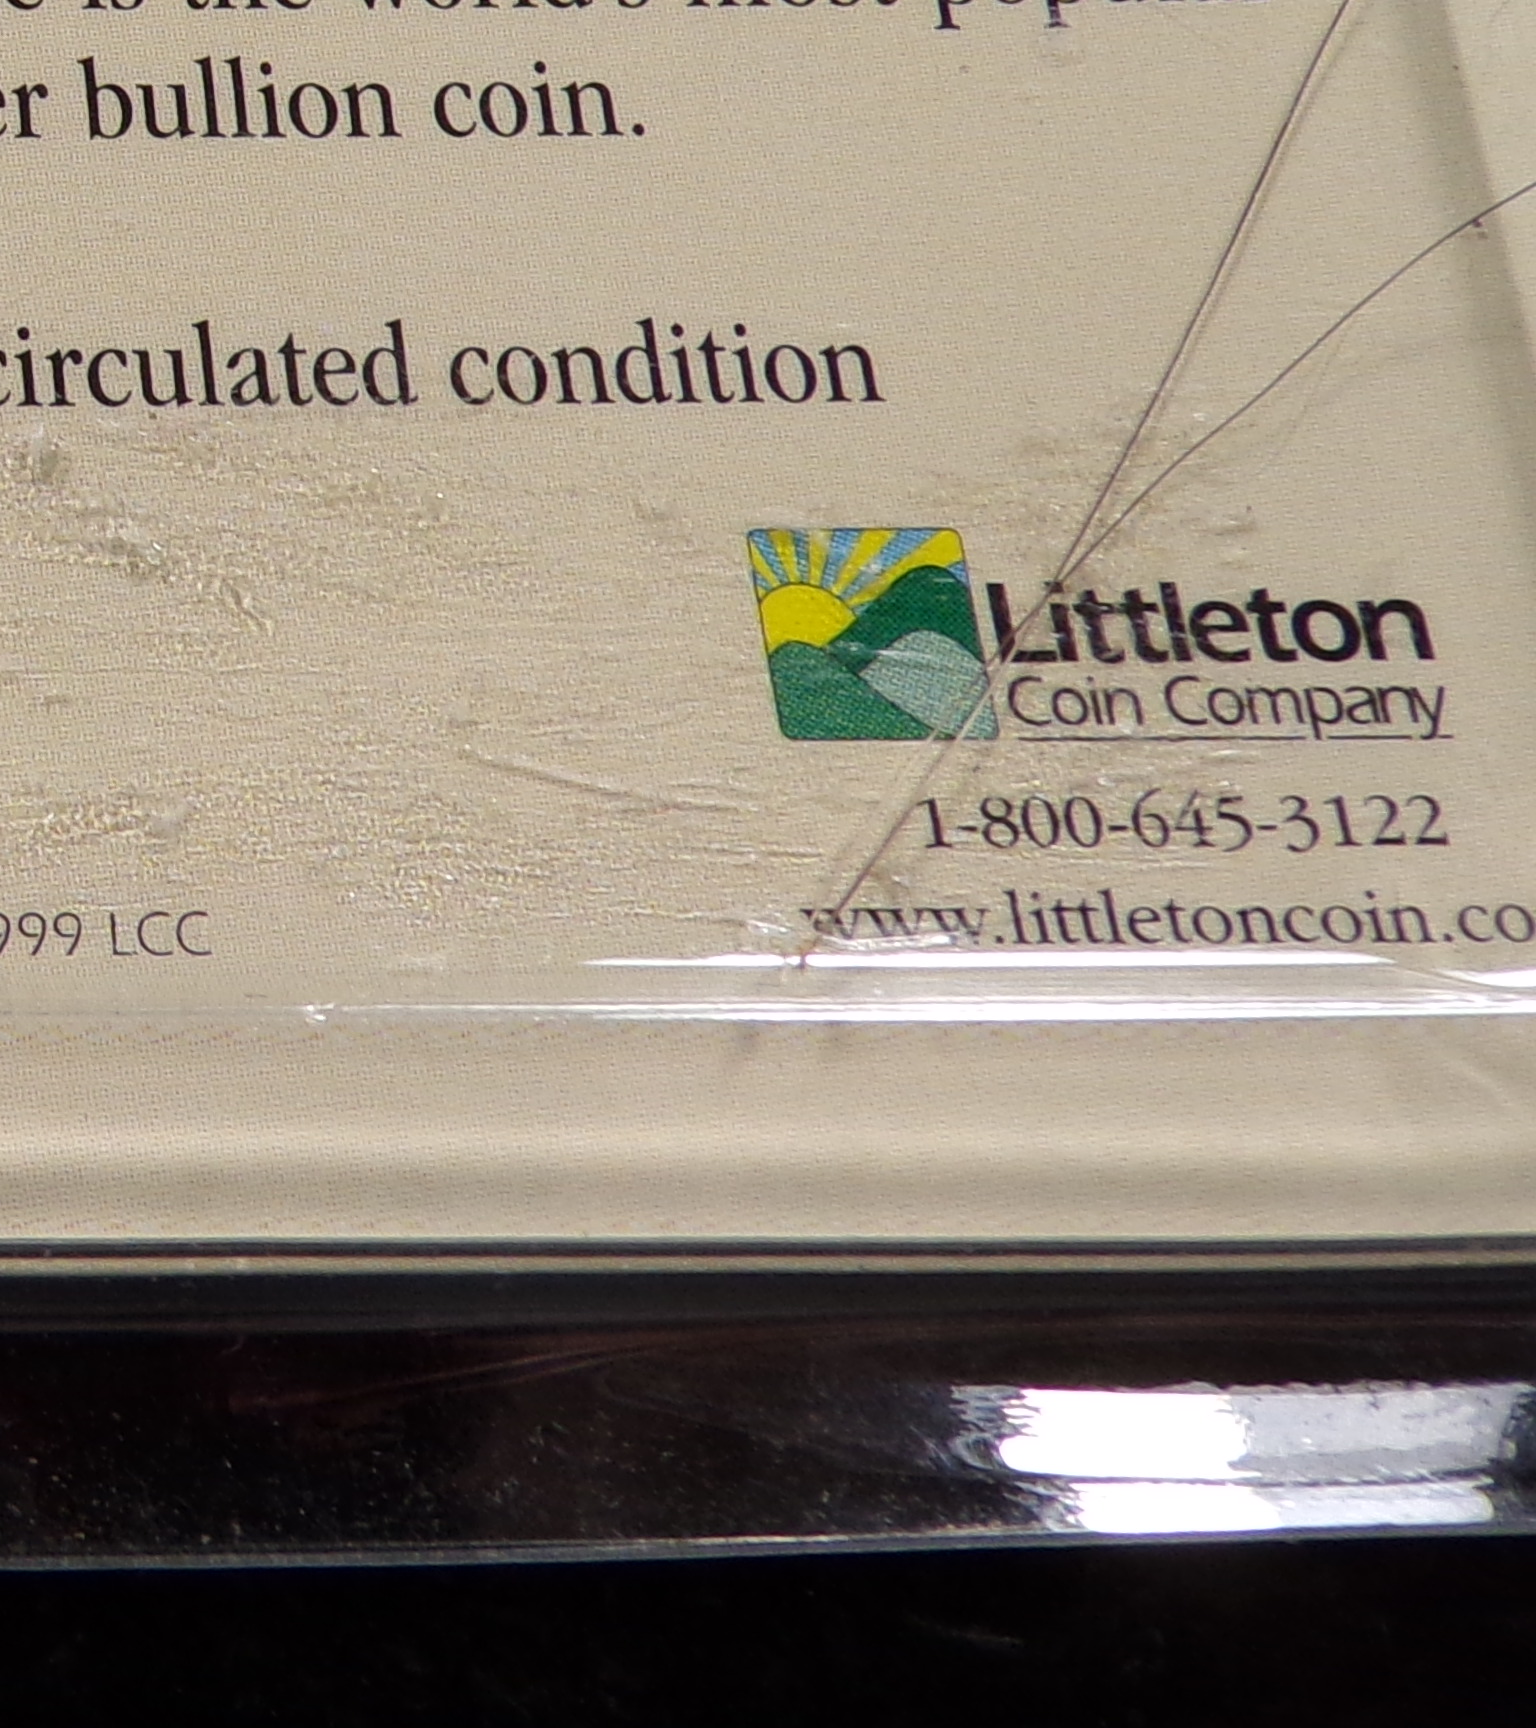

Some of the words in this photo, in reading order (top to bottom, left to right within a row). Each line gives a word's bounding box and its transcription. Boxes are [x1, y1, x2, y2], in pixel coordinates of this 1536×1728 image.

[77, 54, 402, 140] bullion
[433, 60, 645, 138] coin.
[449, 317, 886, 406] condition
[985, 580, 1436, 663] Littleton
[1007, 674, 1143, 728] Coin
[1163, 674, 1446, 740] Company
[916, 786, 1450, 851] 1-800-645-3122
[109, 909, 214, 957] LCC
